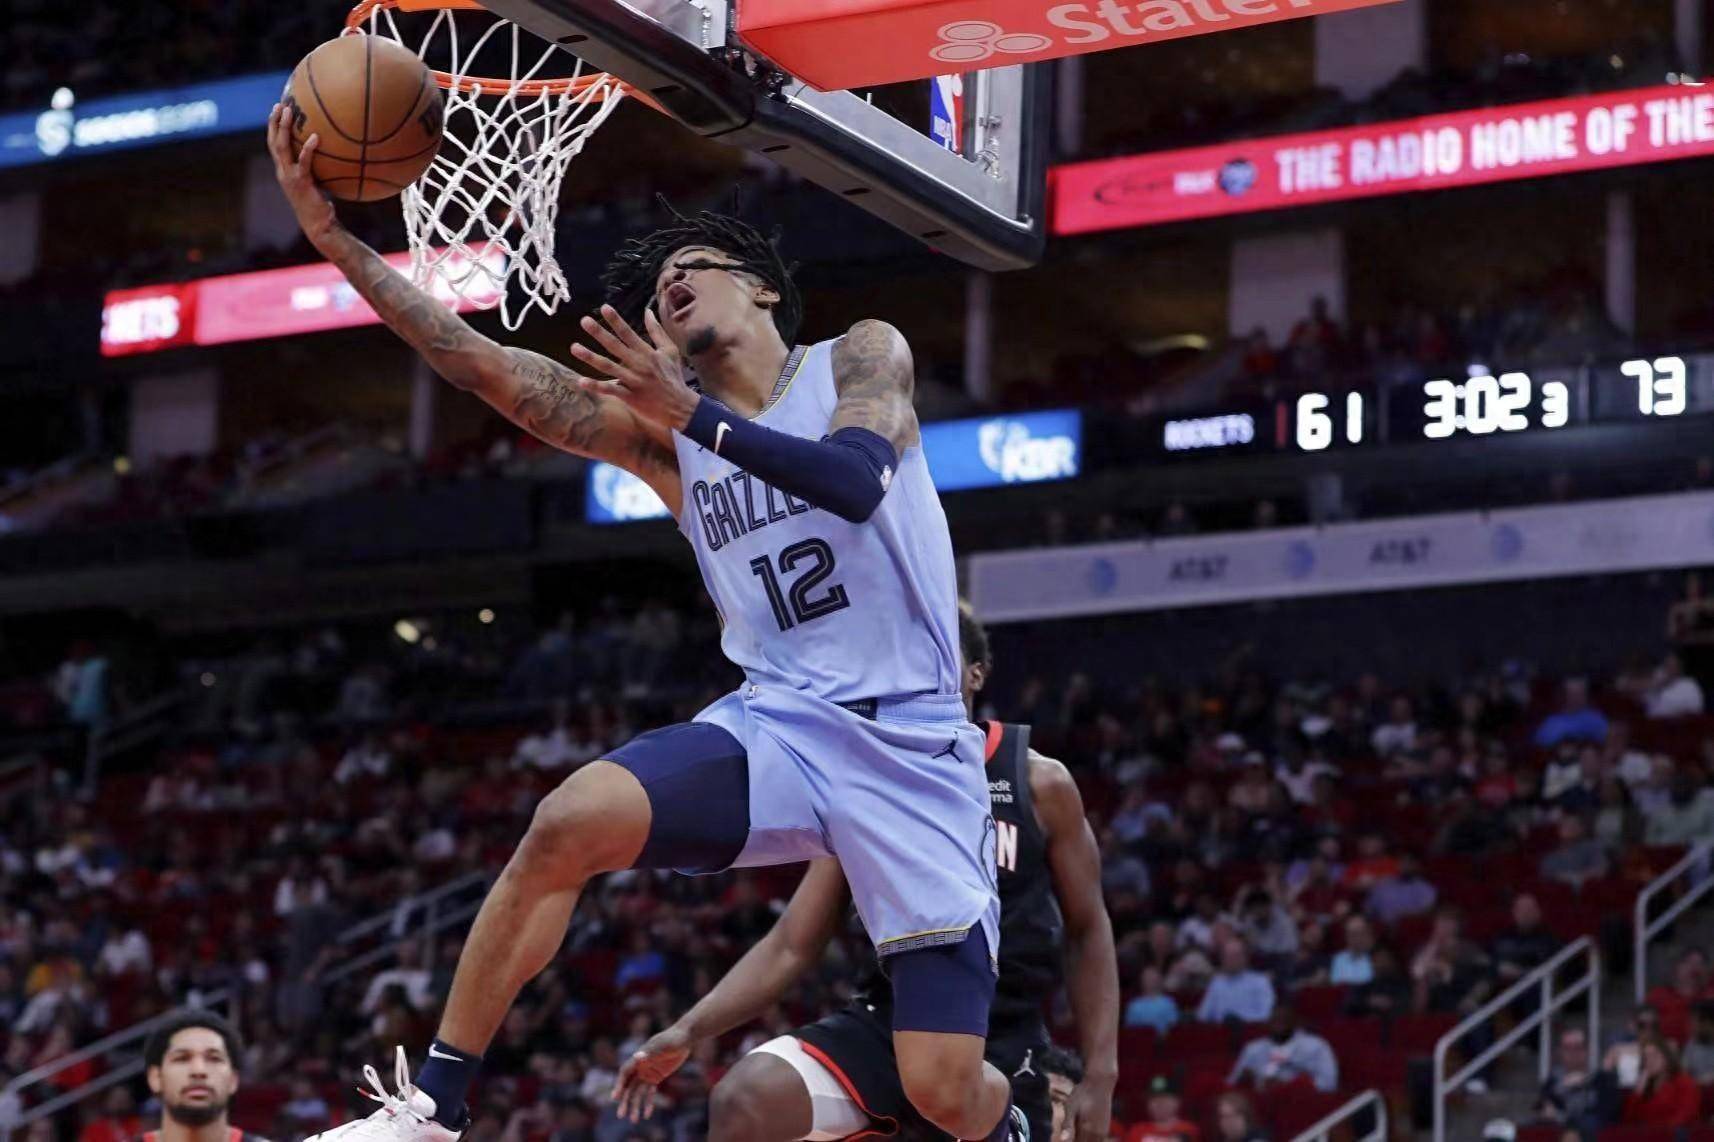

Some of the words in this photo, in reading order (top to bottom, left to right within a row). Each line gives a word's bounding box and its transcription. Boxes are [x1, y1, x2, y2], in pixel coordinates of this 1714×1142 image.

[1274, 142, 1343, 194] THE
[1350, 127, 1462, 186] RADIO
[1470, 112, 1578, 171] HOME
[1585, 104, 1639, 155] OF
[1644, 93, 1714, 148] THE
[1423, 372, 1531, 438] 3:02
[1620, 356, 1686, 416] 73
[1296, 391, 1363, 450] 61
[1169, 555, 1229, 582] AT&T
[1369, 536, 1433, 565] AT&T
[749, 537, 851, 632] 12
